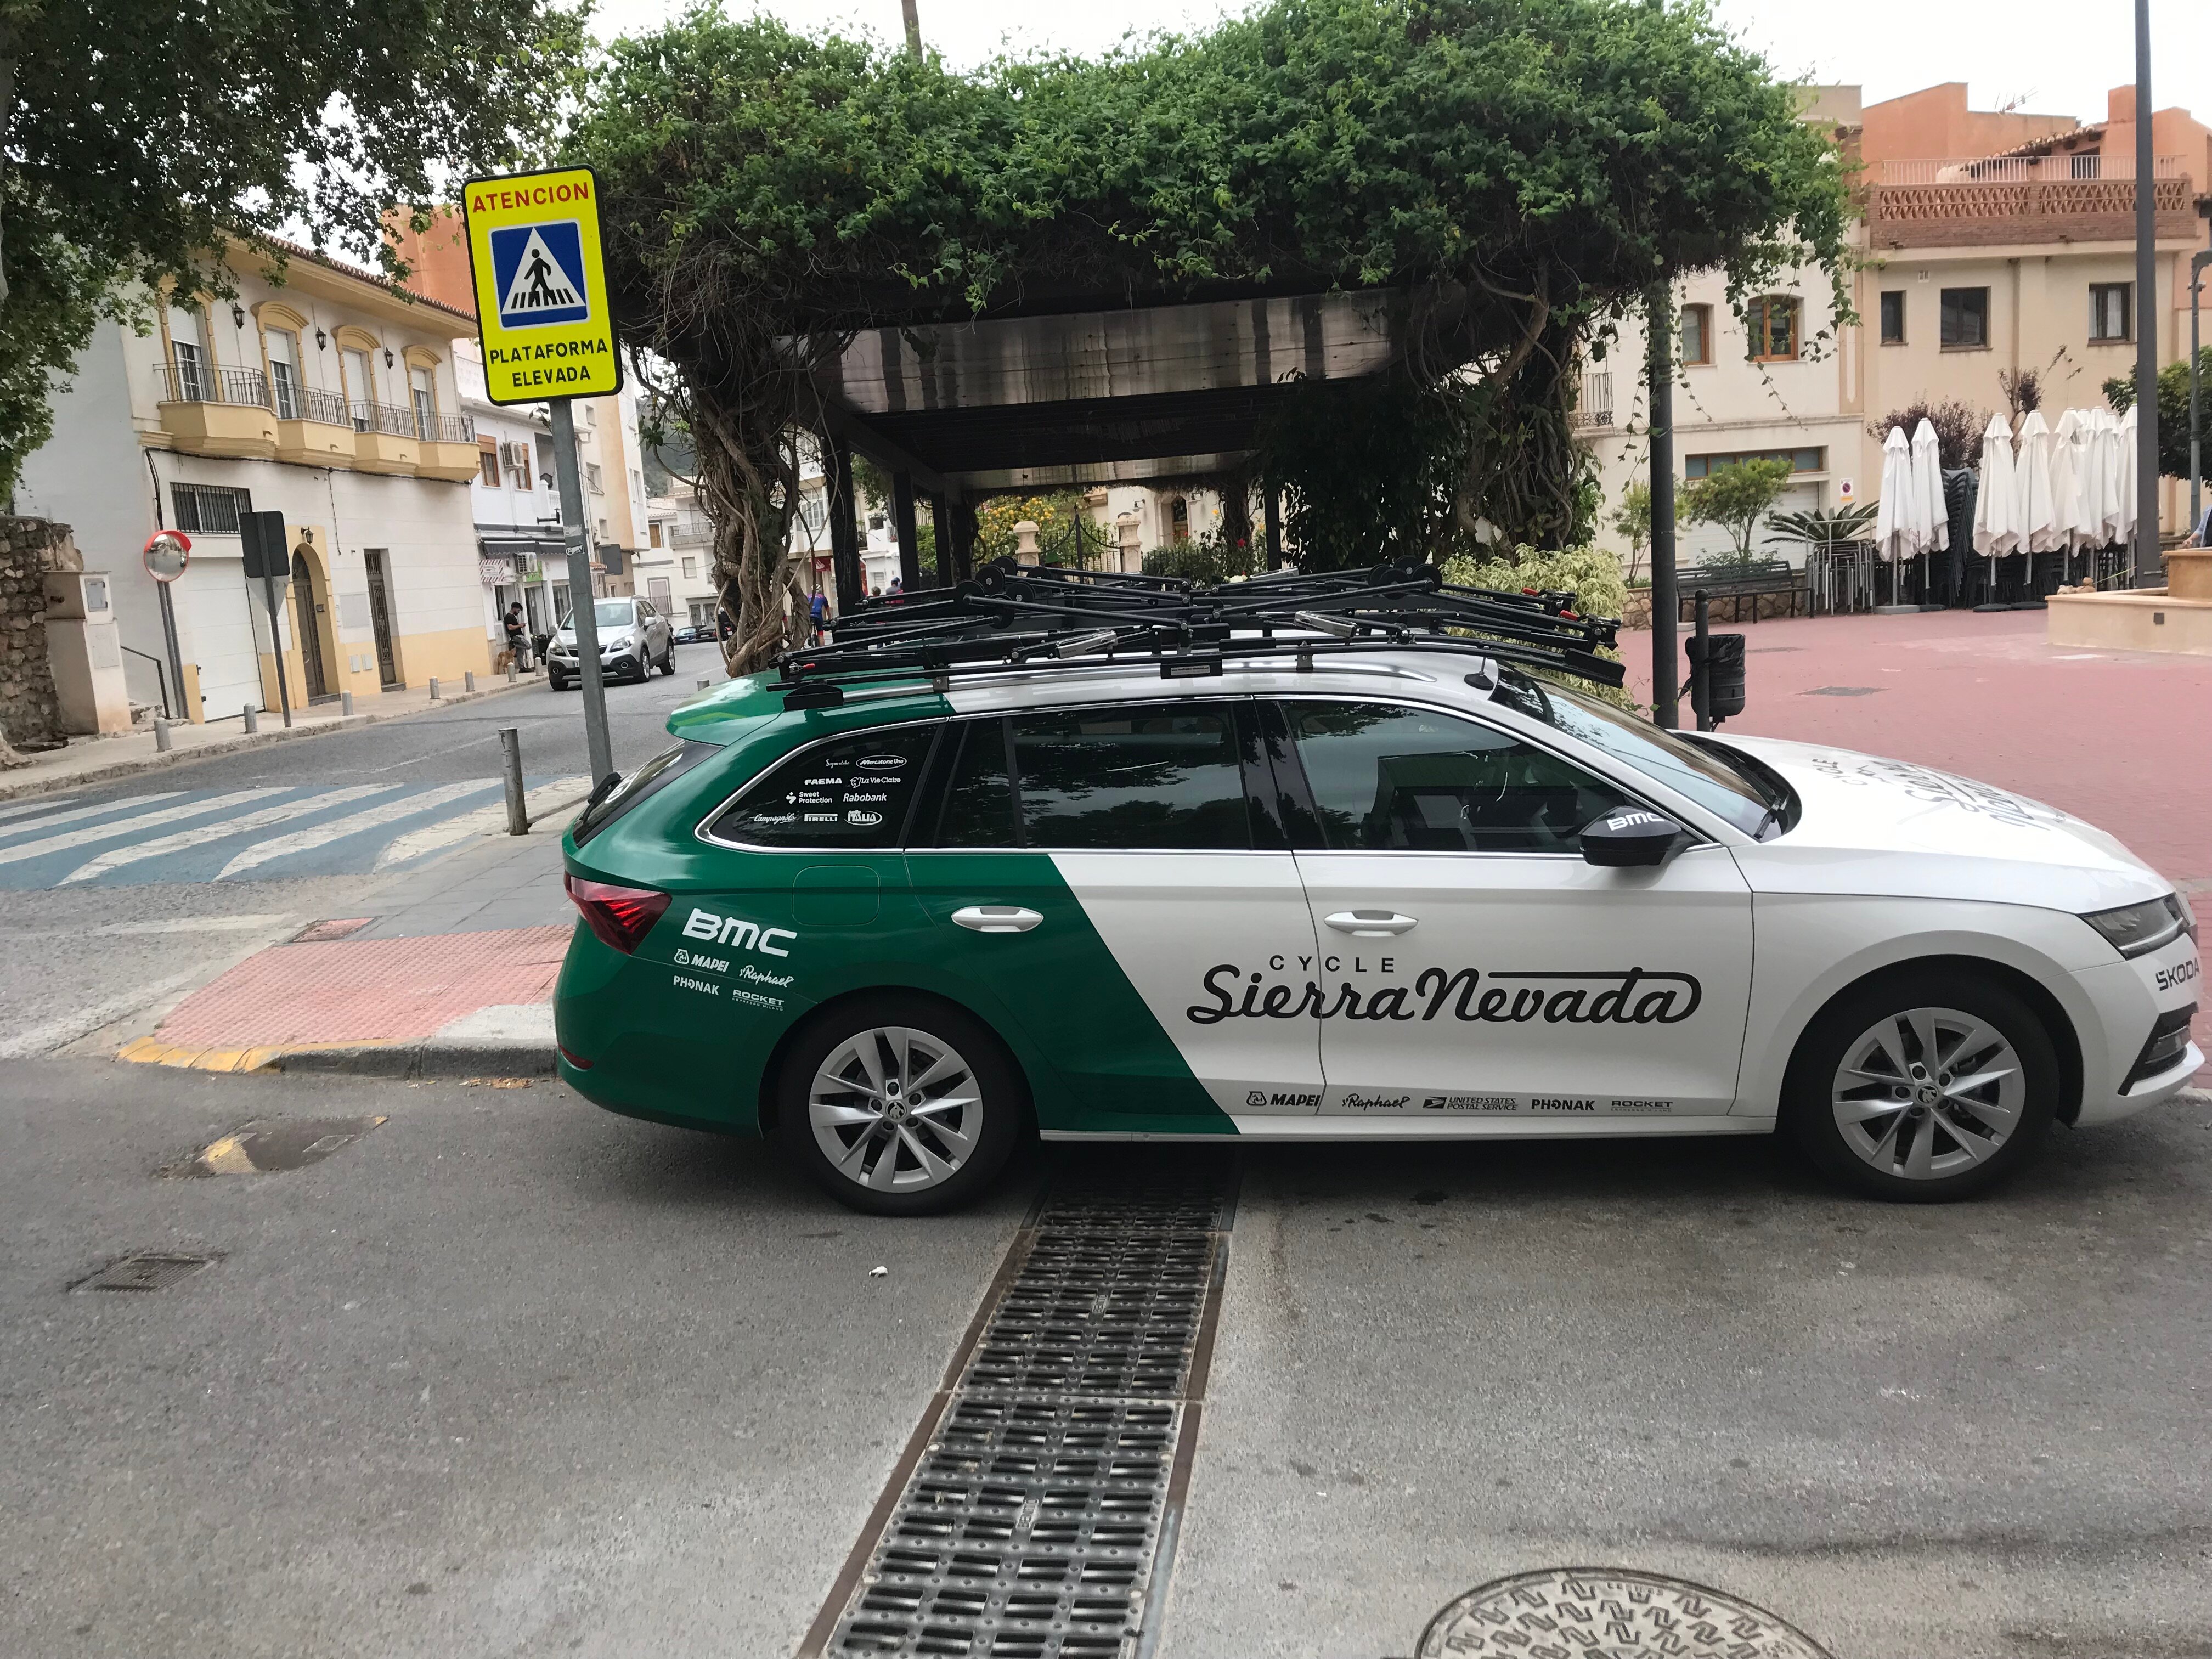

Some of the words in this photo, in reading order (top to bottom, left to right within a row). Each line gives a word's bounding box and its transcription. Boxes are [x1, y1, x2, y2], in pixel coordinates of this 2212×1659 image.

[473, 182, 589, 213] ATENCION
[489, 338, 608, 364] PLATAFORMA
[512, 365, 591, 387] ELEVADA
[843, 792, 887, 802] Rabobank
[749, 812, 797, 825] Campagnolo
[804, 813, 838, 821] PIRELLI
[848, 814, 877, 822] ITALIA
[1606, 812, 1664, 831] BMC
[682, 908, 798, 957] BMC
[691, 954, 730, 972] MAPEI
[1269, 955, 1394, 973] CYCLE
[673, 975, 720, 995] PHONAK
[1186, 963, 1414, 1024] Sierra
[1415, 966, 1702, 1024] Nevada
[733, 989, 785, 1006] ROCKET
[1270, 1093, 1321, 1106] MAPEI
[1531, 1099, 1595, 1111] PHONAK
